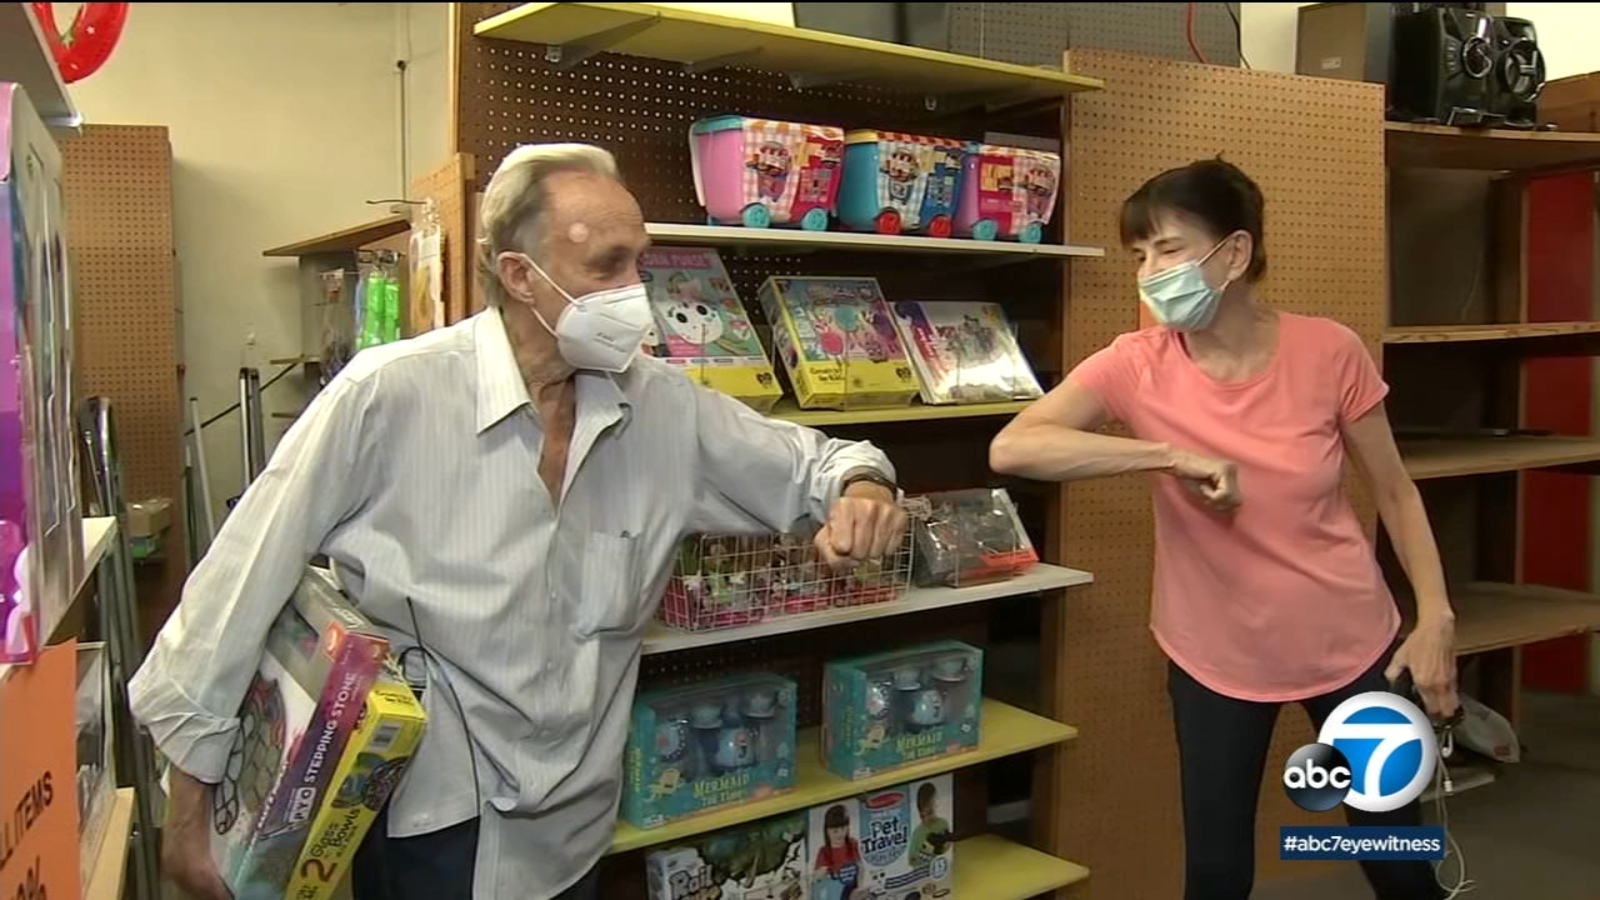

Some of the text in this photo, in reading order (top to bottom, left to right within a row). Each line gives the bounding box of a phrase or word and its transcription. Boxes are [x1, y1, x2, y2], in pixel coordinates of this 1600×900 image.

[305, 719, 338, 783] STEPPING
[332, 672, 357, 717] STONE
[693, 773, 749, 796] MERMAID
[13, 769, 54, 846] ITEMS
[871, 816, 899, 839] Pet
[861, 827, 908, 854] Travel
[301, 859, 338, 883] 2
